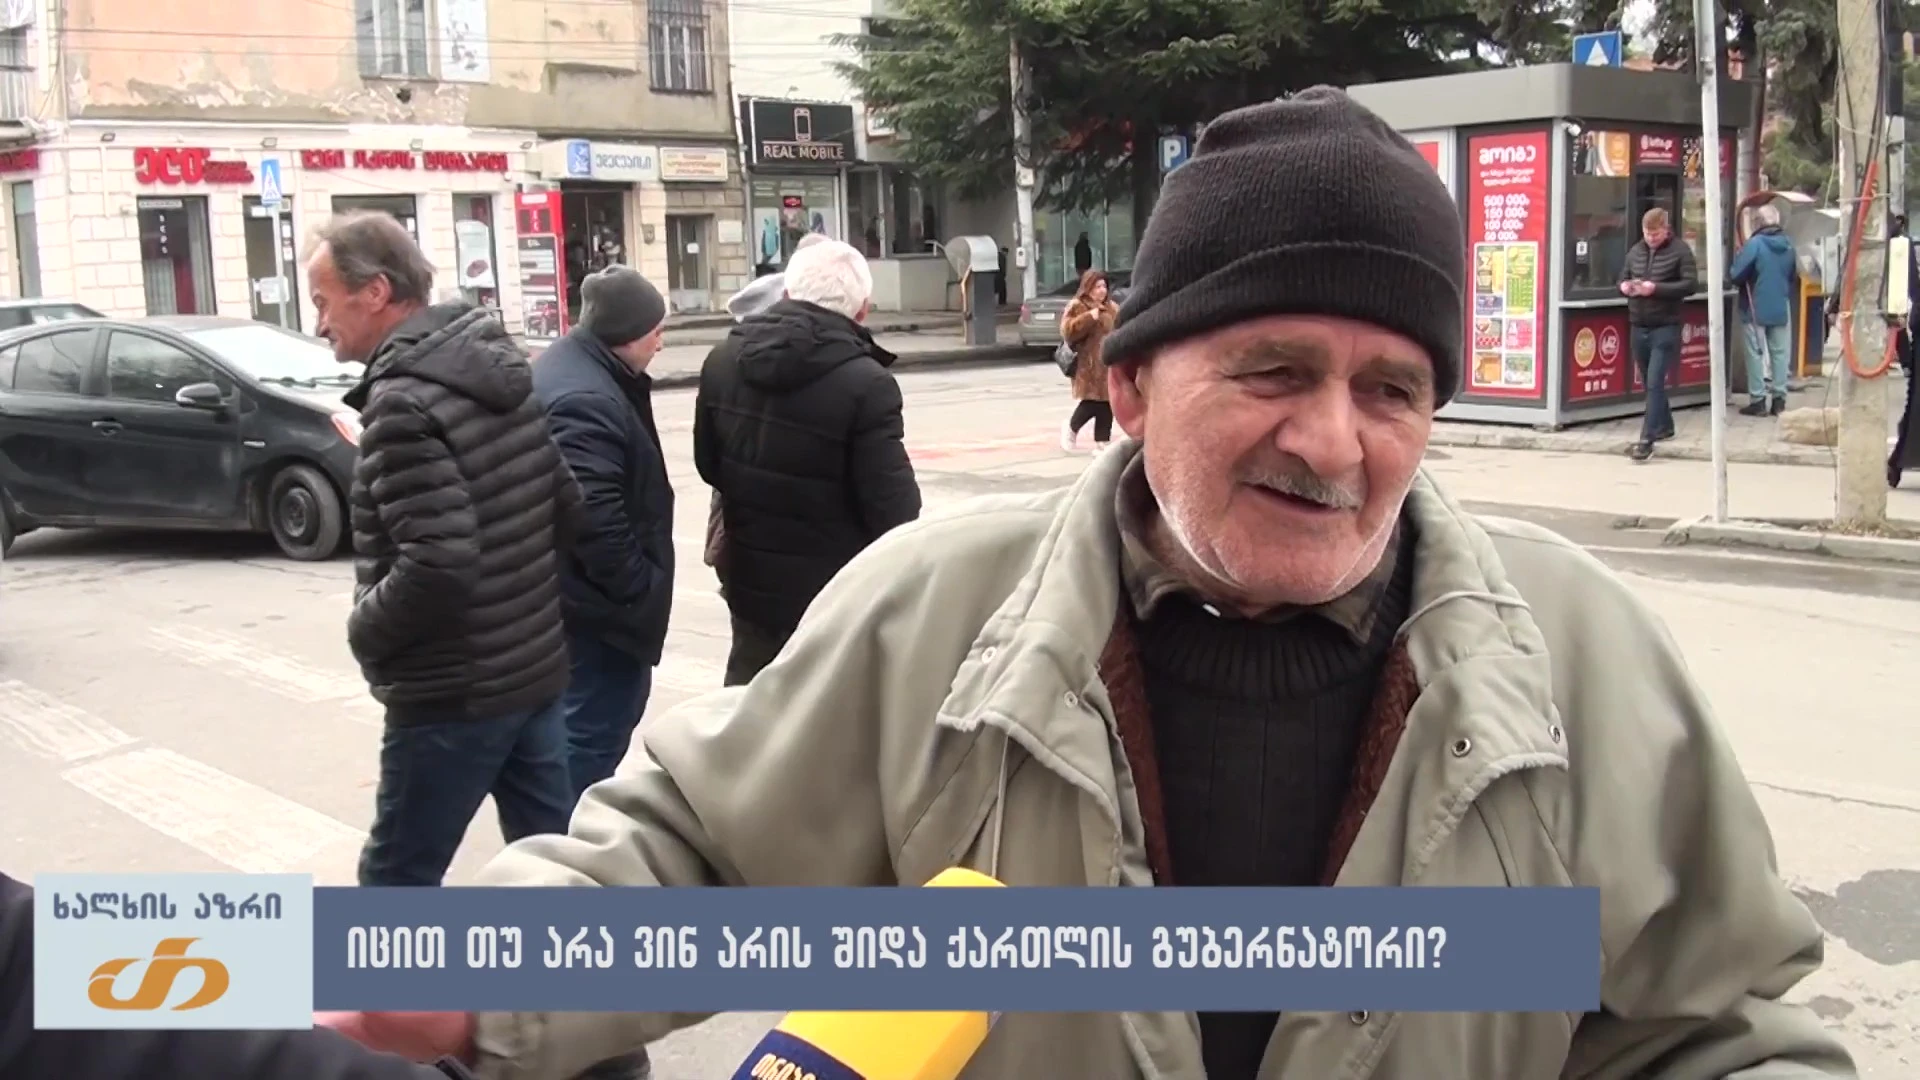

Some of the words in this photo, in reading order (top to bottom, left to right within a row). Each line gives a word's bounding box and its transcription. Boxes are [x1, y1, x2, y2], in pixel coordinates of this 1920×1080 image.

[763, 145, 796, 159] REAL
[799, 146, 845, 160] MOBILE
[1163, 139, 1182, 168] P
[1479, 145, 1536, 165] მოიგე
